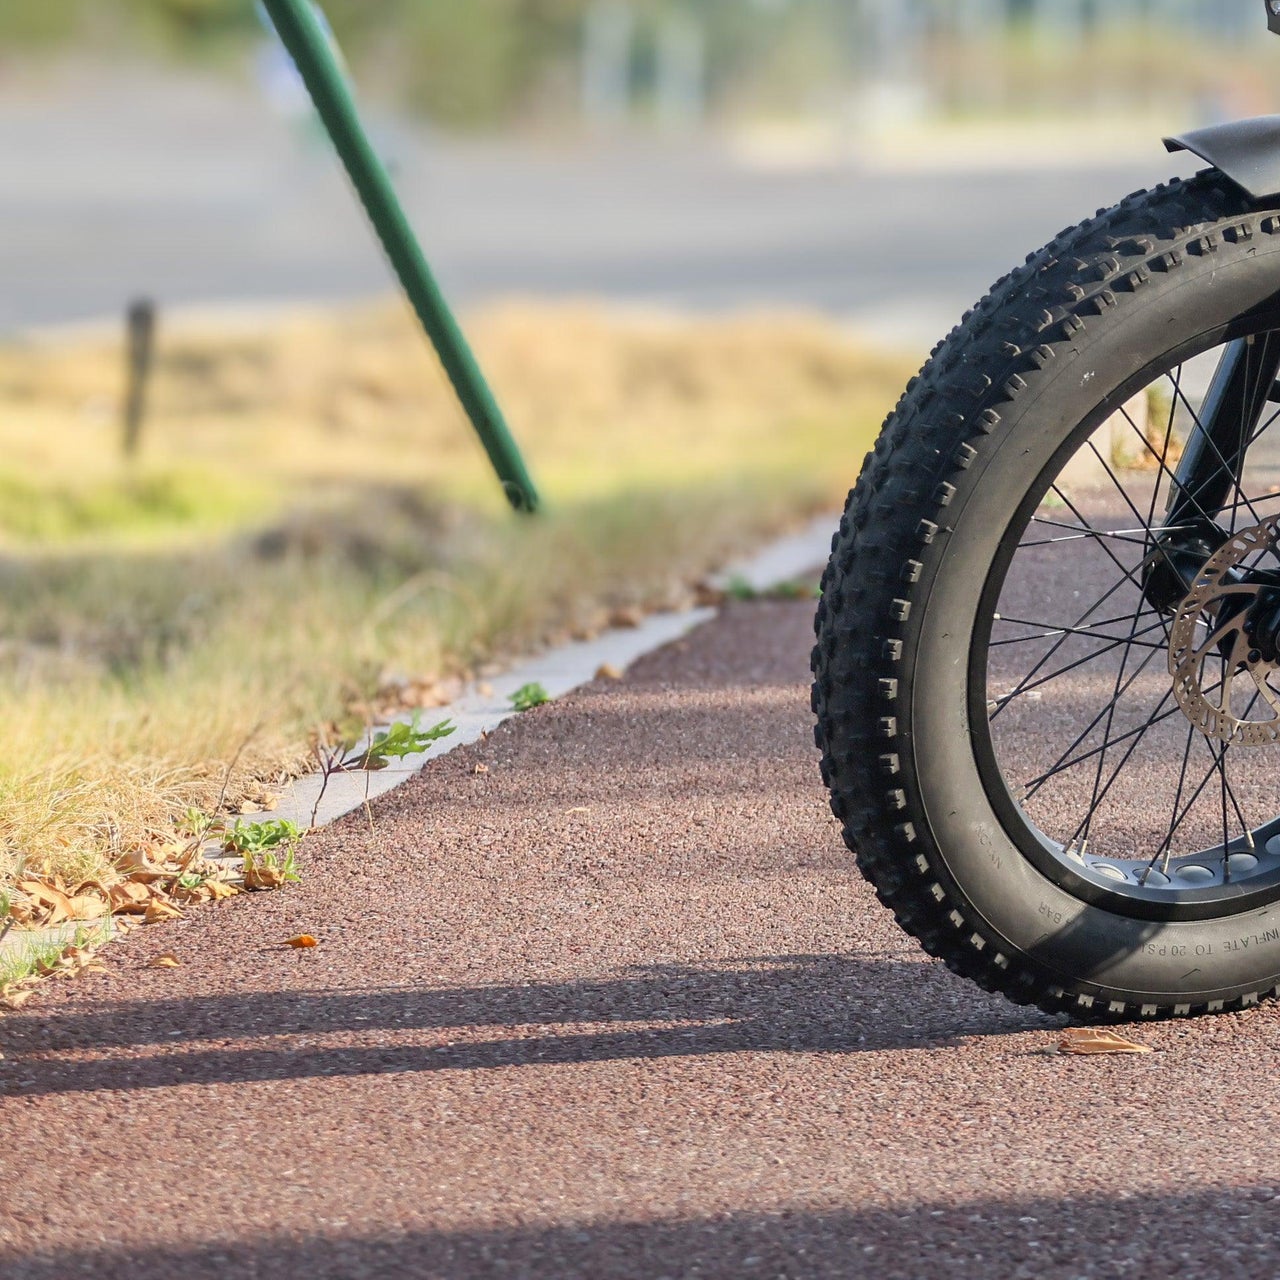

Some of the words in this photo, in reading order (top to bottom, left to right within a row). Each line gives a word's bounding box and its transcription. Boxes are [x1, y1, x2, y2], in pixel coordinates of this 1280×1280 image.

[1038, 901, 1062, 924] BAR
[1223, 927, 1280, 952] INFLATE
[1171, 944, 1186, 956] 20
[1195, 944, 1212, 956] TO
